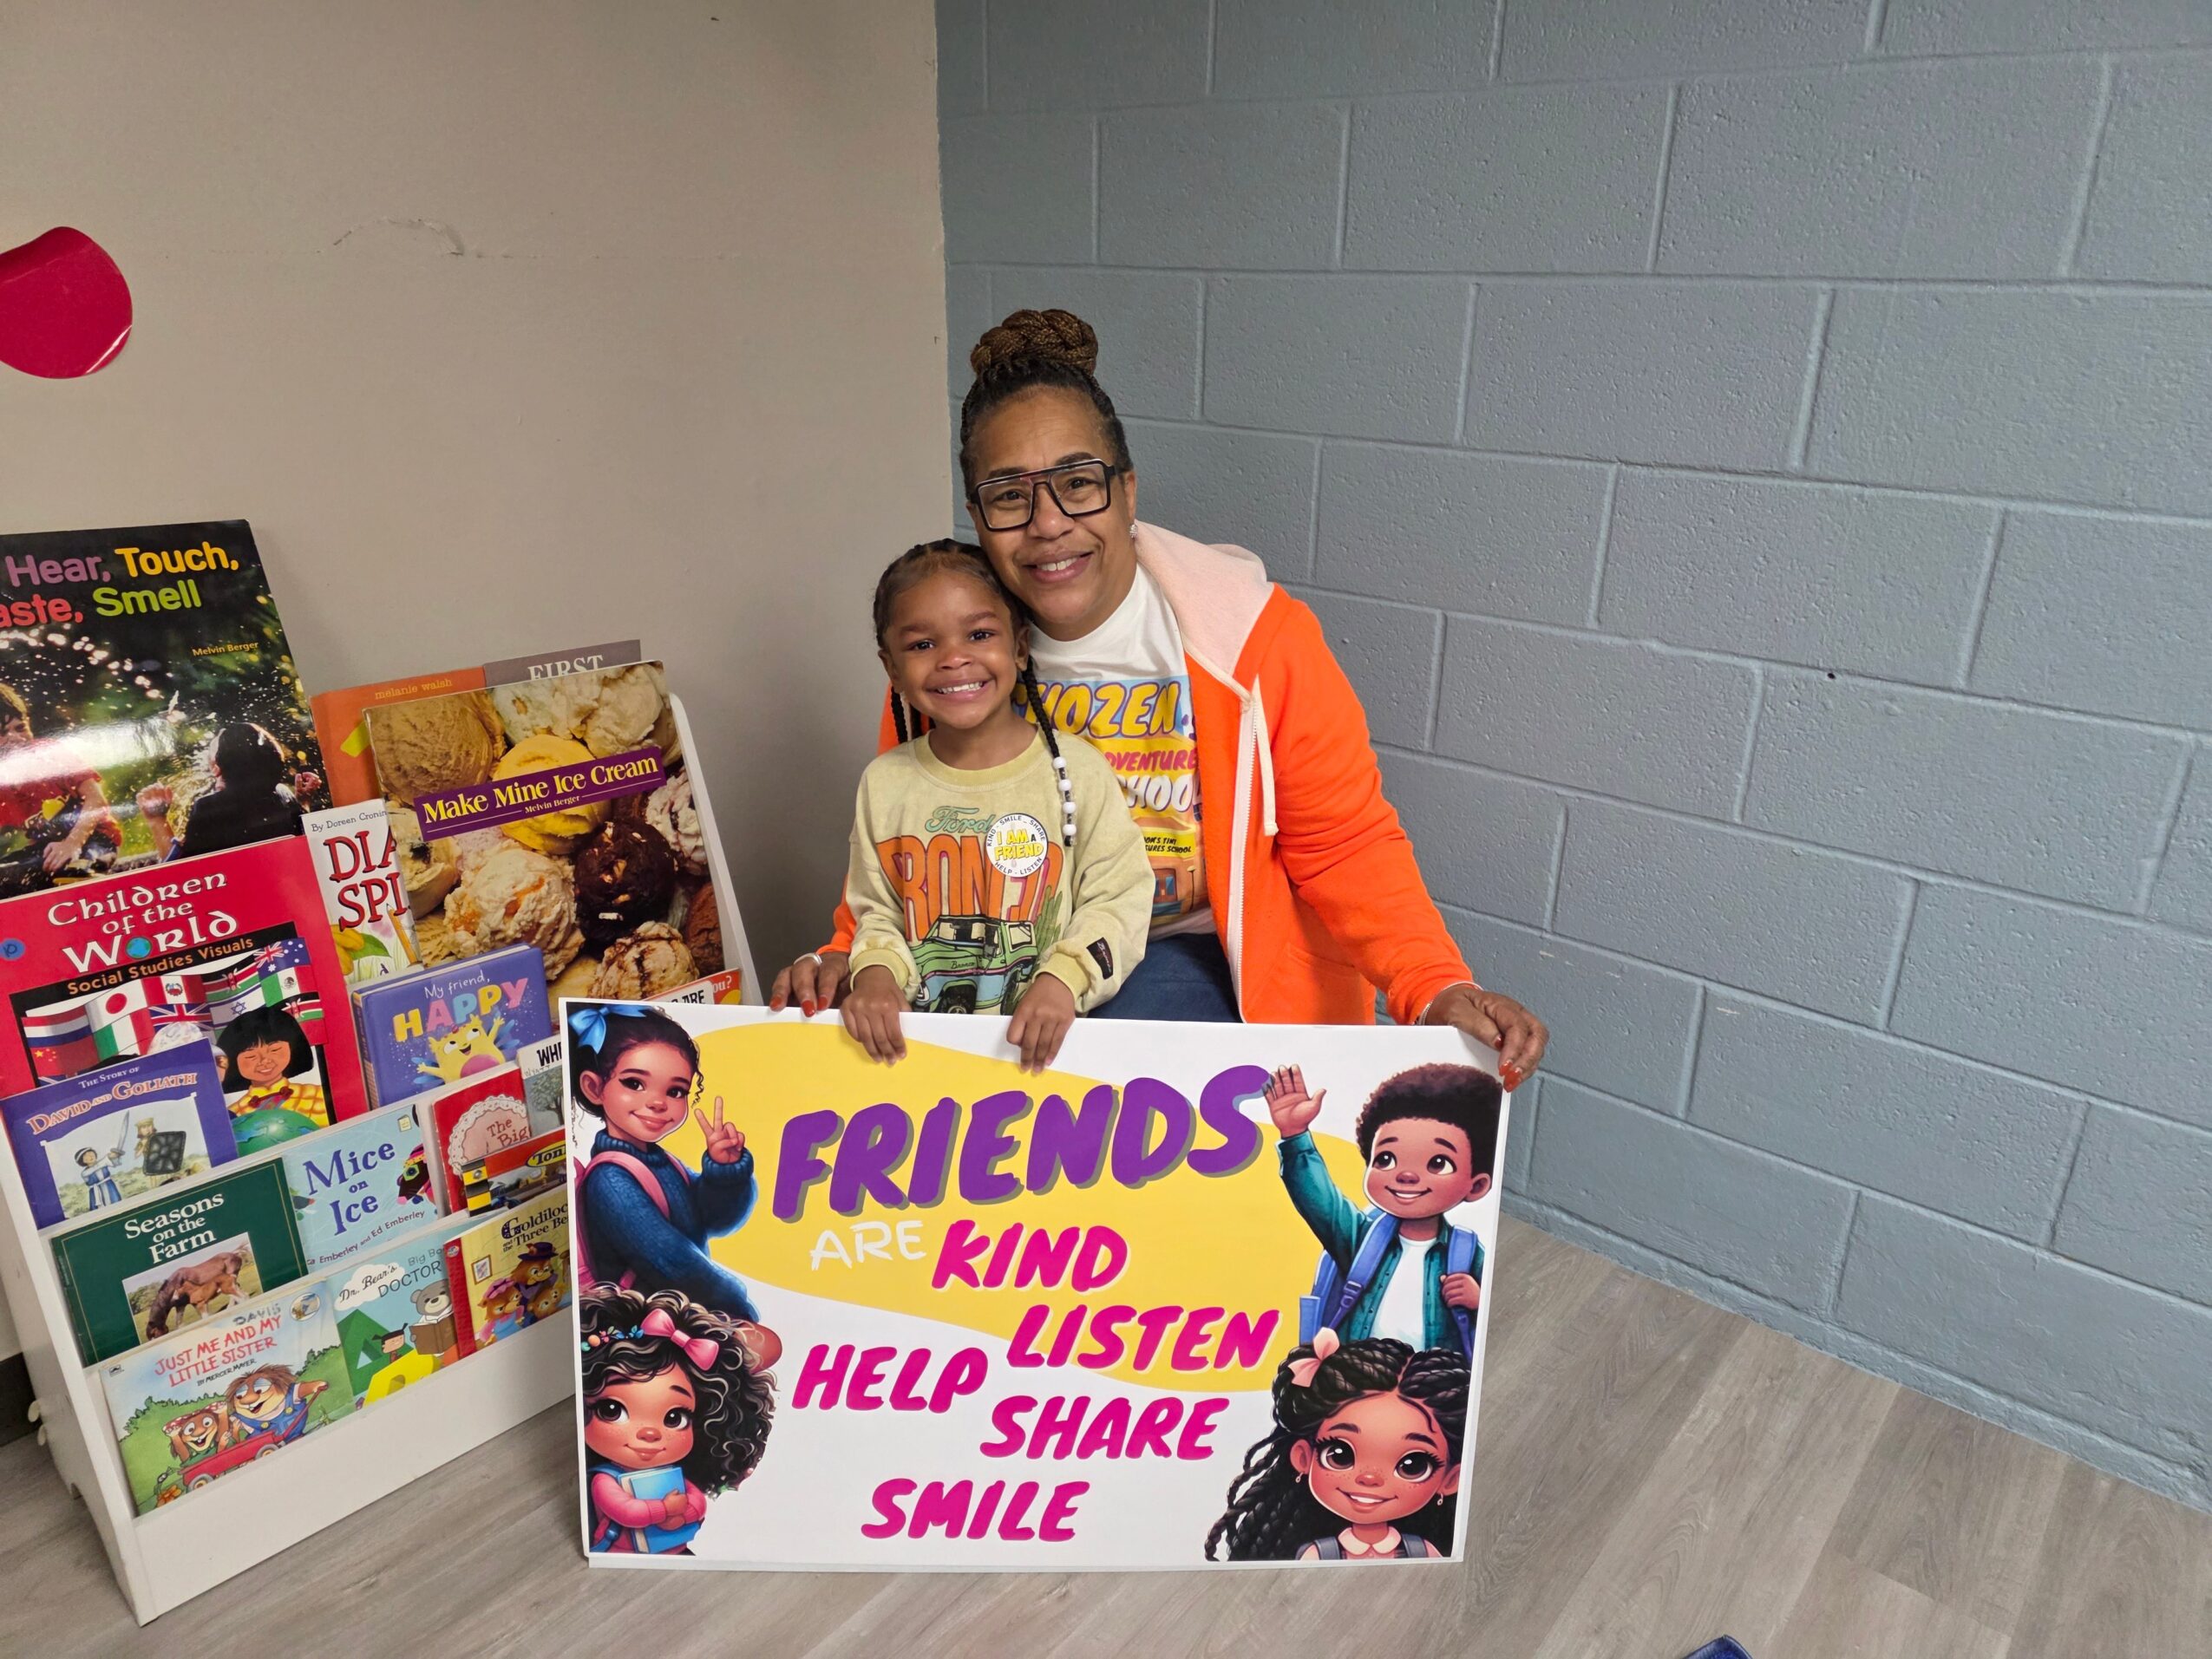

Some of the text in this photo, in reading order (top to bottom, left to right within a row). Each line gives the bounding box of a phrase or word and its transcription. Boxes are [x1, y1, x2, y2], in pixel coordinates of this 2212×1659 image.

[4, 541, 239, 587] Hear, Touch,
[93, 579, 202, 617] Smell
[192, 641, 259, 656] Melvin Berger
[374, 677, 453, 701] melanie walsh
[422, 757, 659, 824] Make Mine Ice Cream
[525, 795, 580, 814] Melvin Berger
[311, 810, 388, 833] By Doreen Cronin
[925, 806, 997, 833] Ford
[987, 815, 1046, 846] KIND SMILE SHARE
[996, 827, 1037, 846] I AM A
[993, 842, 1044, 861] FRIEND
[994, 857, 1043, 875] HELP LISTEN
[48, 872, 227, 926] Children
[101, 902, 193, 935] of the
[68, 937, 254, 996] Social Studies Visuals
[424, 970, 491, 999] My friend,
[392, 977, 529, 1042] HAPPY
[487, 1119, 513, 1137] The
[497, 1127, 533, 1147] Big
[773, 1064, 1273, 1221] FRIENDS
[303, 1143, 396, 1195] Mice
[349, 1180, 369, 1194] on
[124, 1192, 225, 1239] Seasons
[152, 1215, 206, 1244] on the
[329, 1195, 379, 1236] Ice
[514, 1216, 569, 1246] Three Be
[148, 1230, 217, 1264] Farm
[319, 1243, 358, 1264] Emberley
[360, 1236, 371, 1245] and
[370, 1225, 383, 1238] Ed
[384, 1211, 425, 1230] Emberley
[809, 1218, 1129, 1293] ARE KIND
[378, 1260, 442, 1297] DOCTOR
[408, 1255, 426, 1267] Big
[339, 1264, 397, 1303] Dr. Bear's
[154, 1315, 282, 1375] JUST ME AND MY
[1005, 1303, 1279, 1372] LISTEN
[169, 1336, 278, 1388] LITTLE SISTER
[791, 1343, 989, 1414] HELP
[979, 1394, 1230, 1460] SHARE
[861, 1477, 1090, 1542] SMILE
